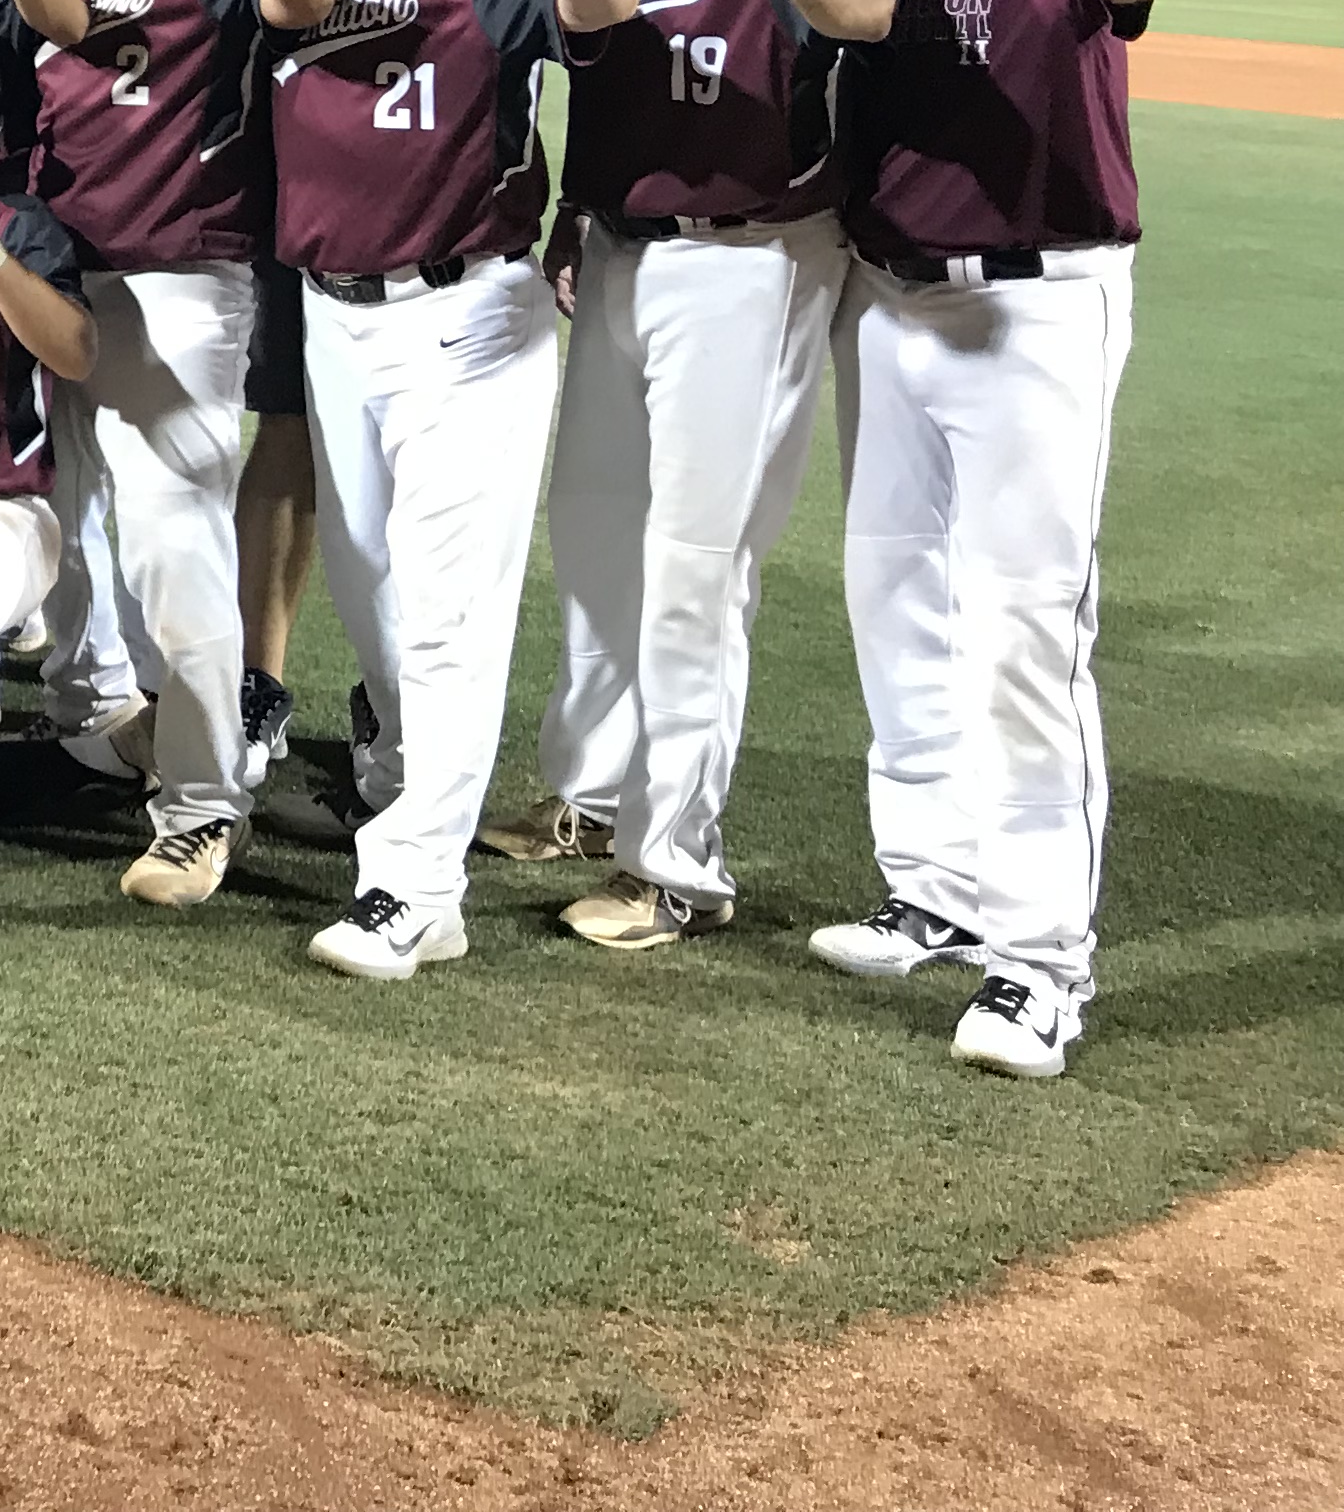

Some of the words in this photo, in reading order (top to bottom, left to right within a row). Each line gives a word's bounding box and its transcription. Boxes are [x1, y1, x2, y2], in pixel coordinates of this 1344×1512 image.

[111, 43, 151, 106] 2
[373, 60, 436, 132] 21
[668, 33, 728, 106] 19
